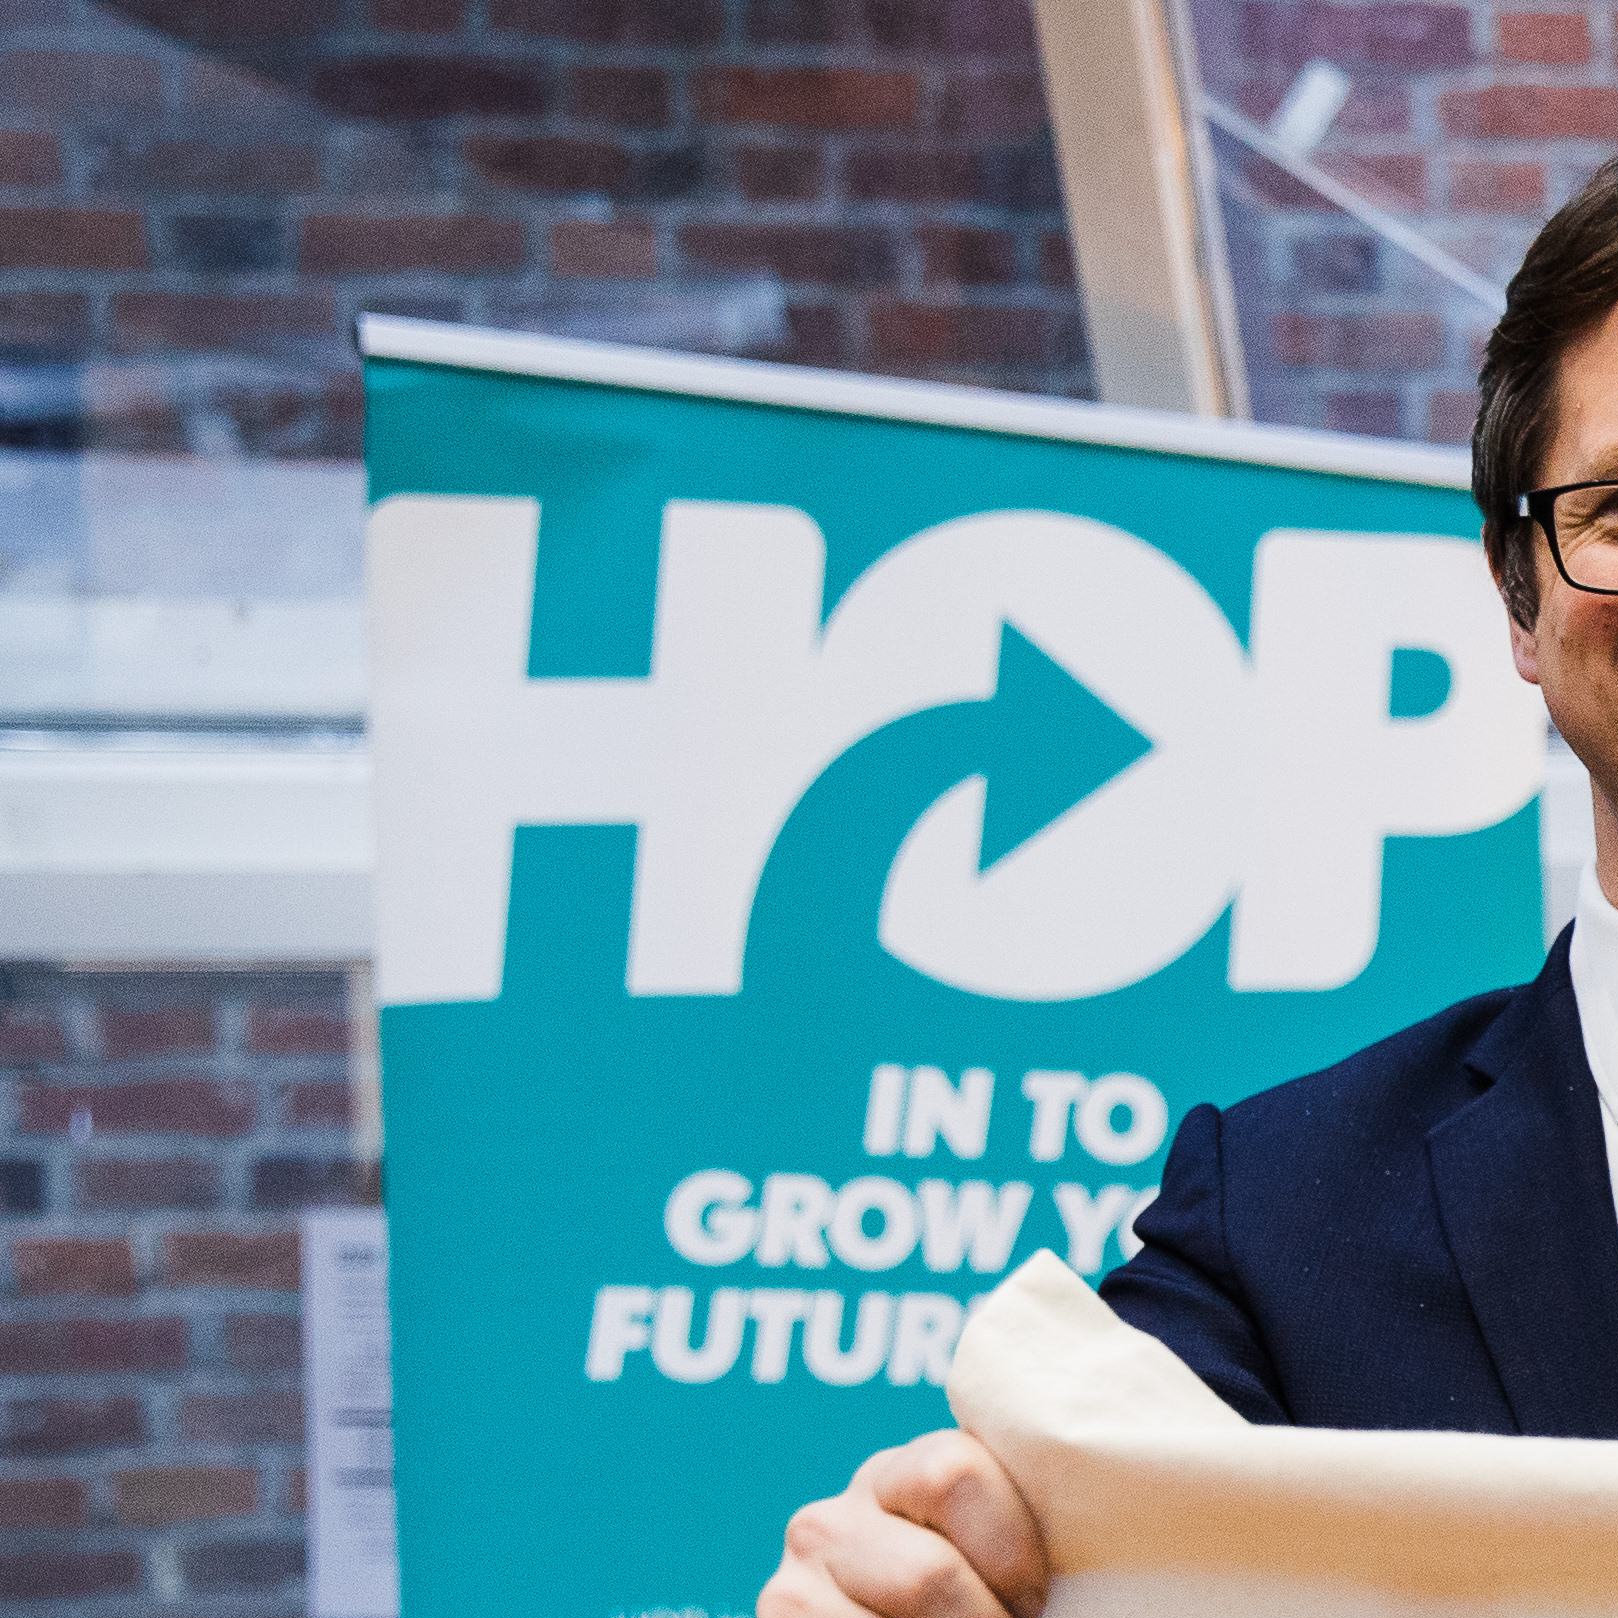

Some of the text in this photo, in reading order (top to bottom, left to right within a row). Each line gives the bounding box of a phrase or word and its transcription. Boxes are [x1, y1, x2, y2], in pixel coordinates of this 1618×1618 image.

[364, 490, 1547, 1004] HOP
[862, 1062, 1168, 1166] IN TO
[663, 1168, 1035, 1274] GROW
[585, 1284, 992, 1388] FUTUR
